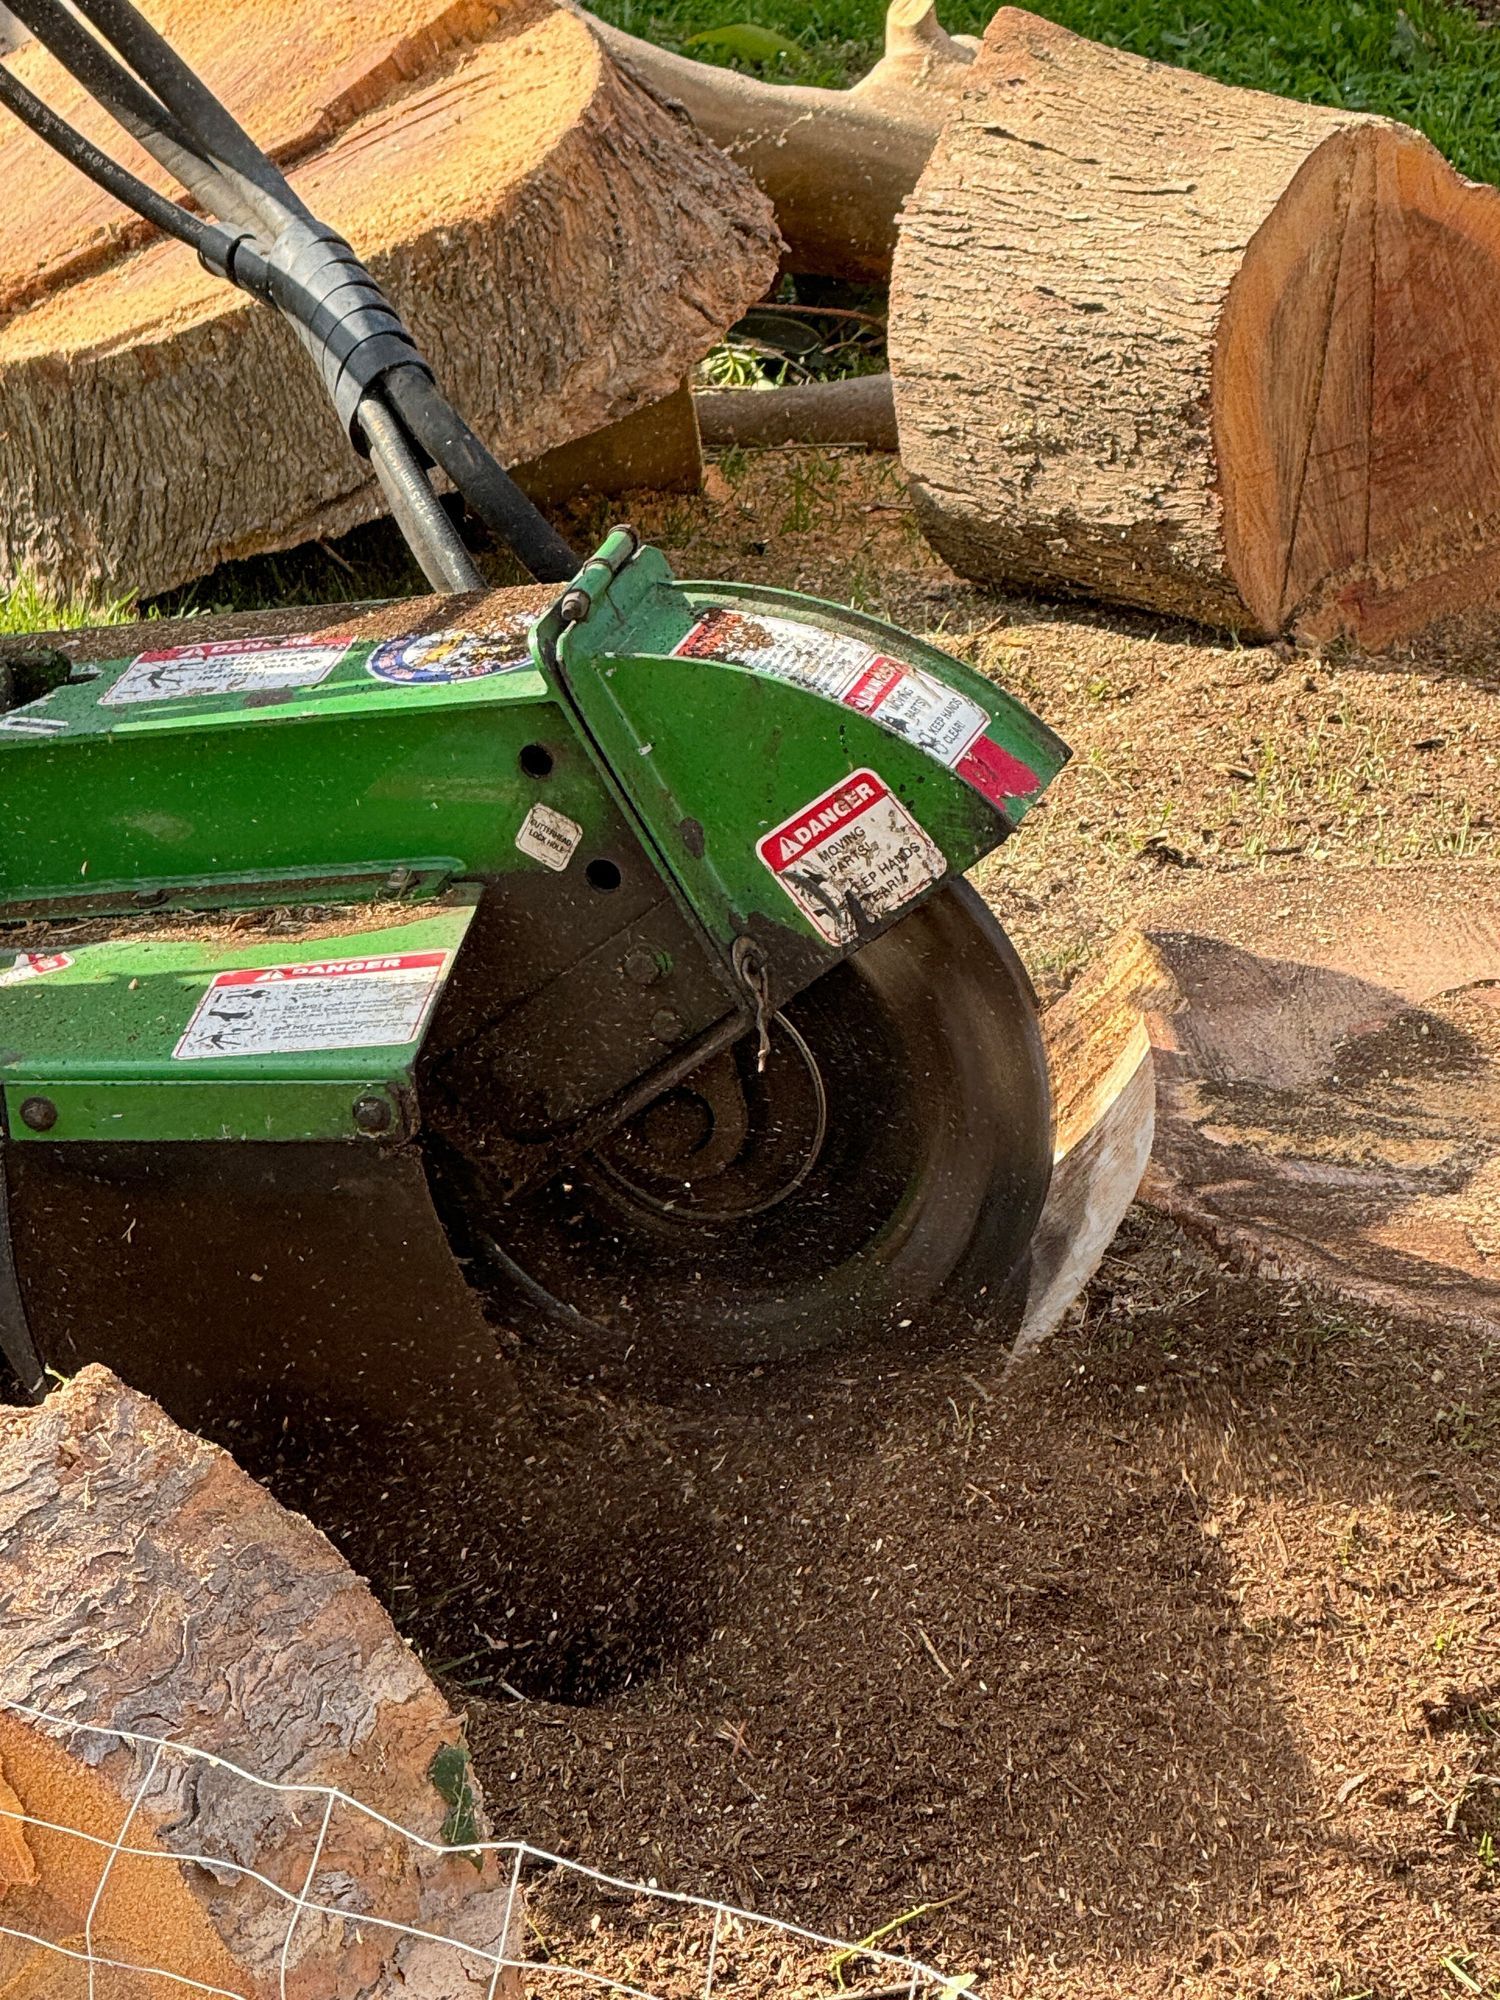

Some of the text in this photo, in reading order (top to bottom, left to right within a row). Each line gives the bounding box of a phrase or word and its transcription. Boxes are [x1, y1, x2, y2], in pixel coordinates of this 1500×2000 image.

[400, 469, 416, 491] mm
[410, 490, 429, 515] 12.5
[211, 637, 312, 653] DANER
[928, 697, 963, 736] KEEP HANDS
[943, 720, 966, 745] CLEAR!
[794, 782, 875, 848] DANGER
[529, 828, 547, 843] LOCK
[818, 826, 866, 864] MOVING
[828, 842, 873, 877] PARTS!
[878, 842, 921, 876] HANDS
[291, 958, 402, 975] DANGER
